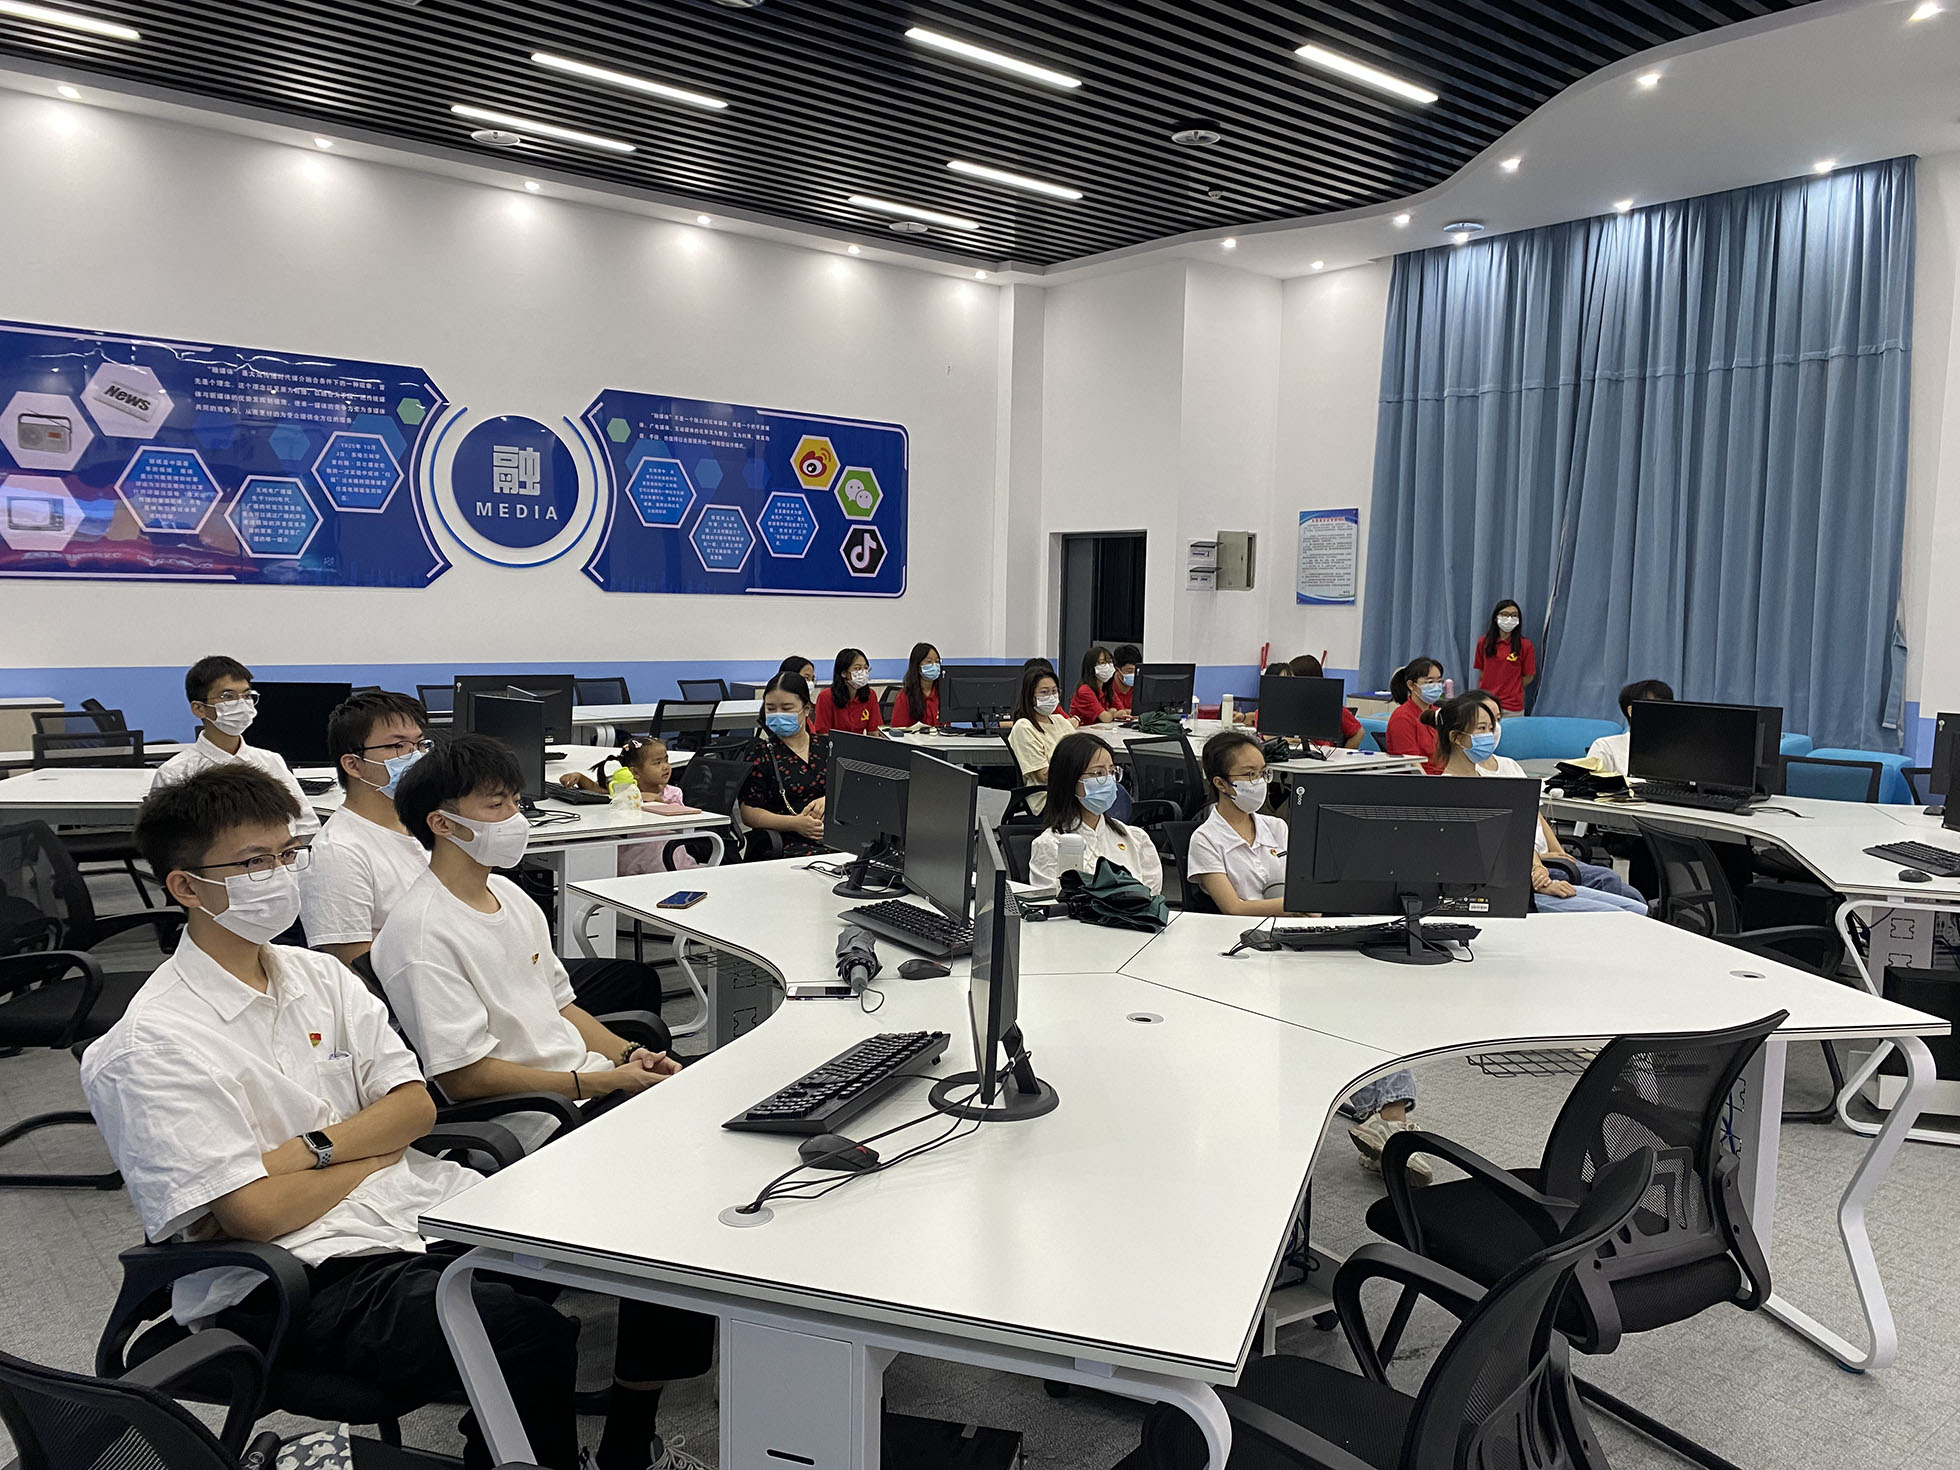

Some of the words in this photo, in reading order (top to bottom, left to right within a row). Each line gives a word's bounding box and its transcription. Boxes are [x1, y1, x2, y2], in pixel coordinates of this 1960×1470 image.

[104, 384, 151, 412] News
[492, 444, 541, 496] 融
[476, 502, 558, 520] MEDIA
